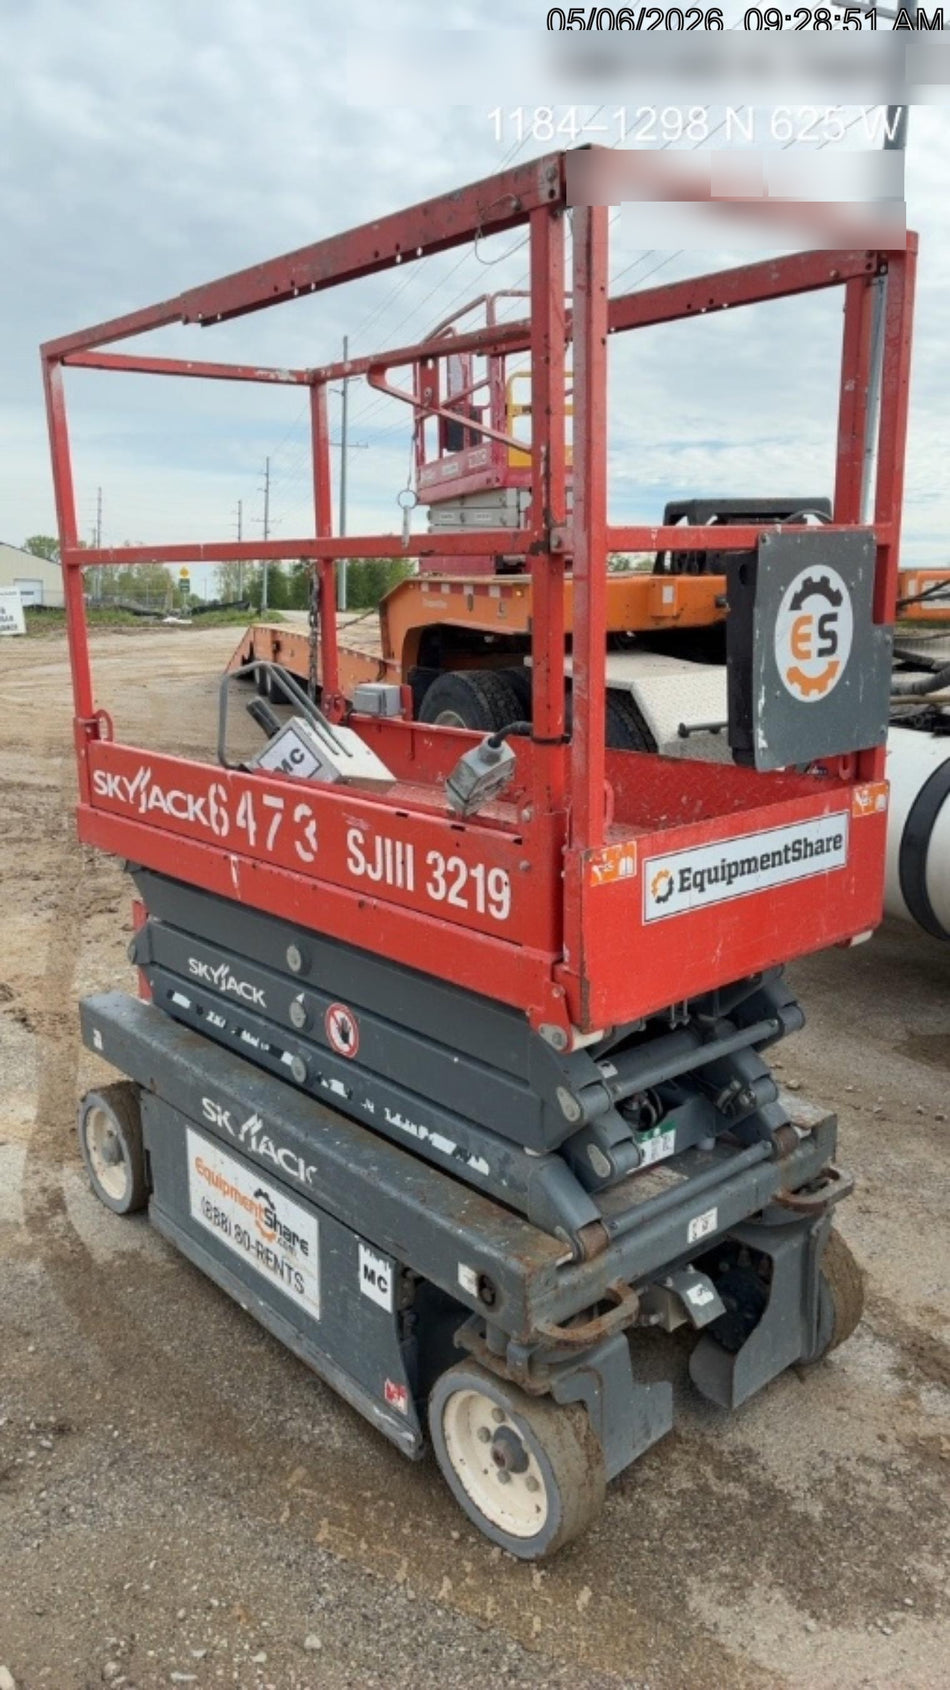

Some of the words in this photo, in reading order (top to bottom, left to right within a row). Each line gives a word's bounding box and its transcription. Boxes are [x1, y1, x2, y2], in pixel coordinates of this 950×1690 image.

[790, 612, 838, 661] ES
[92, 765, 211, 827] SKYJACK
[208, 783, 318, 863] 6473
[346, 828, 415, 892] SJIII
[426, 850, 512, 921] 3219
[678, 833, 844, 893] EquipmentShare
[188, 957, 267, 1009] SKYJACK
[233, 1224, 305, 1295] 80-RENTS
[363, 1263, 388, 1294] MC
